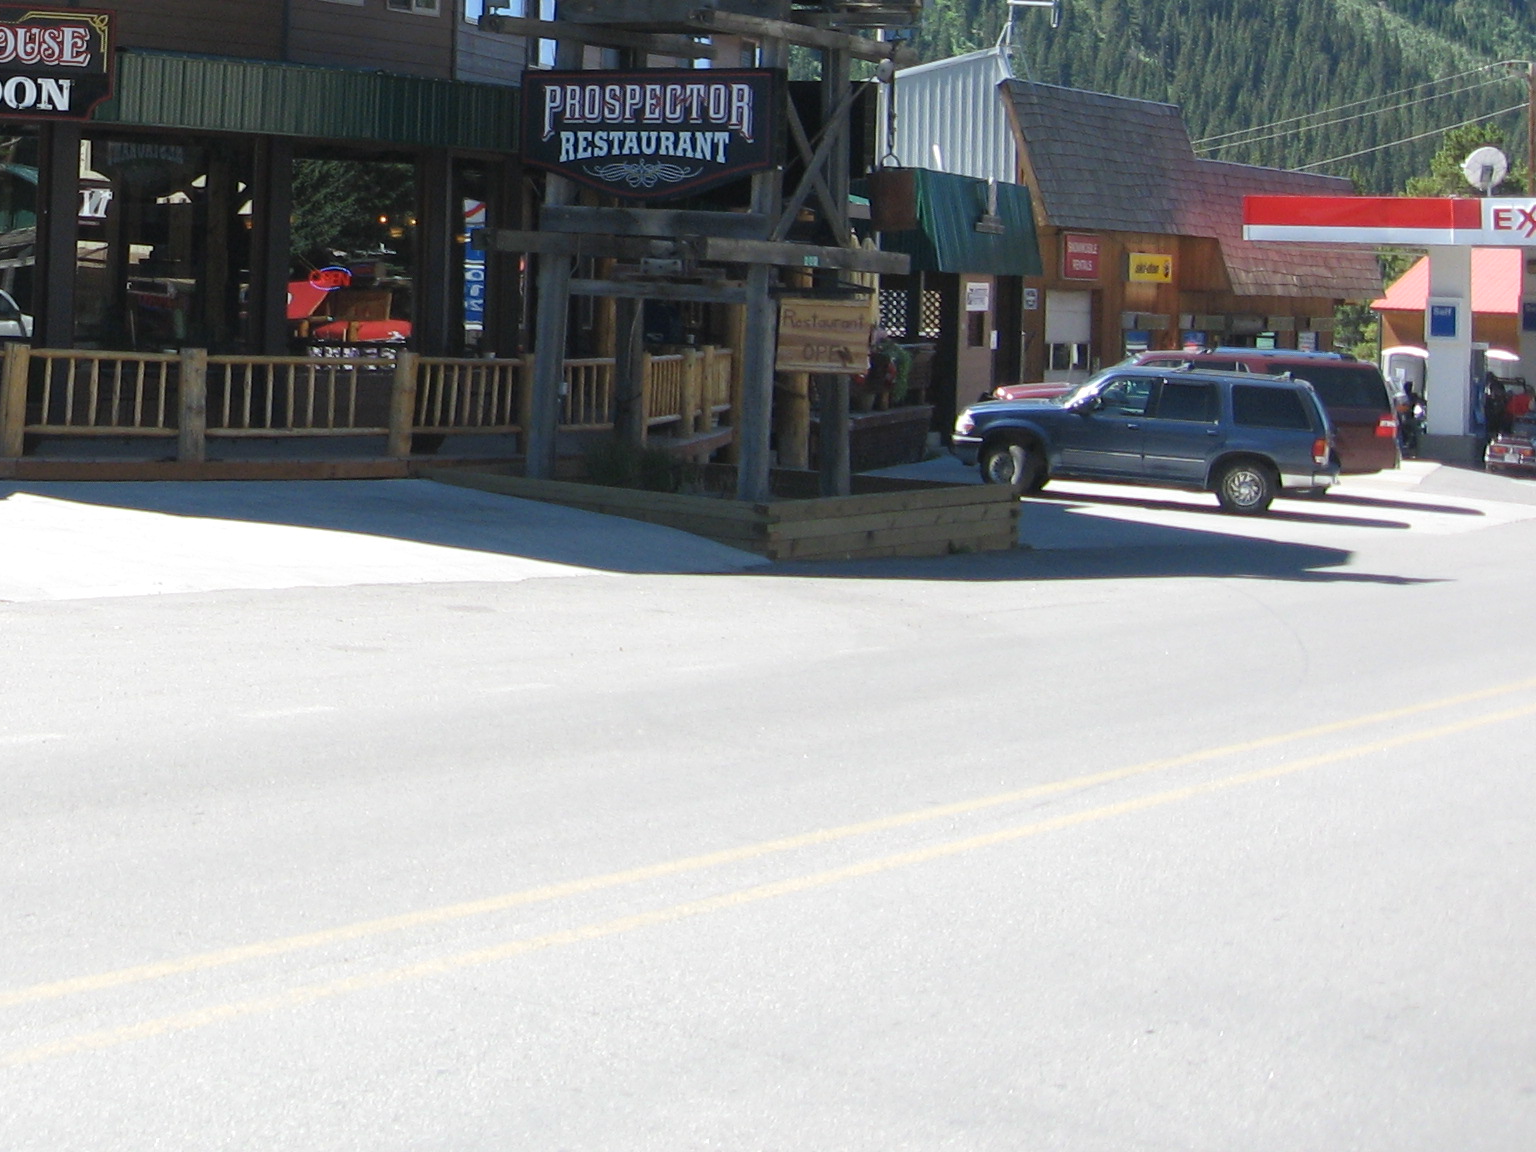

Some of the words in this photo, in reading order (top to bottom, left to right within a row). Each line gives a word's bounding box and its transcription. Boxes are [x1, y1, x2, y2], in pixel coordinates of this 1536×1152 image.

[542, 83, 755, 144] PROSPECTOR
[559, 130, 731, 165] RESTAURANT
[782, 308, 865, 330] Restaurant
